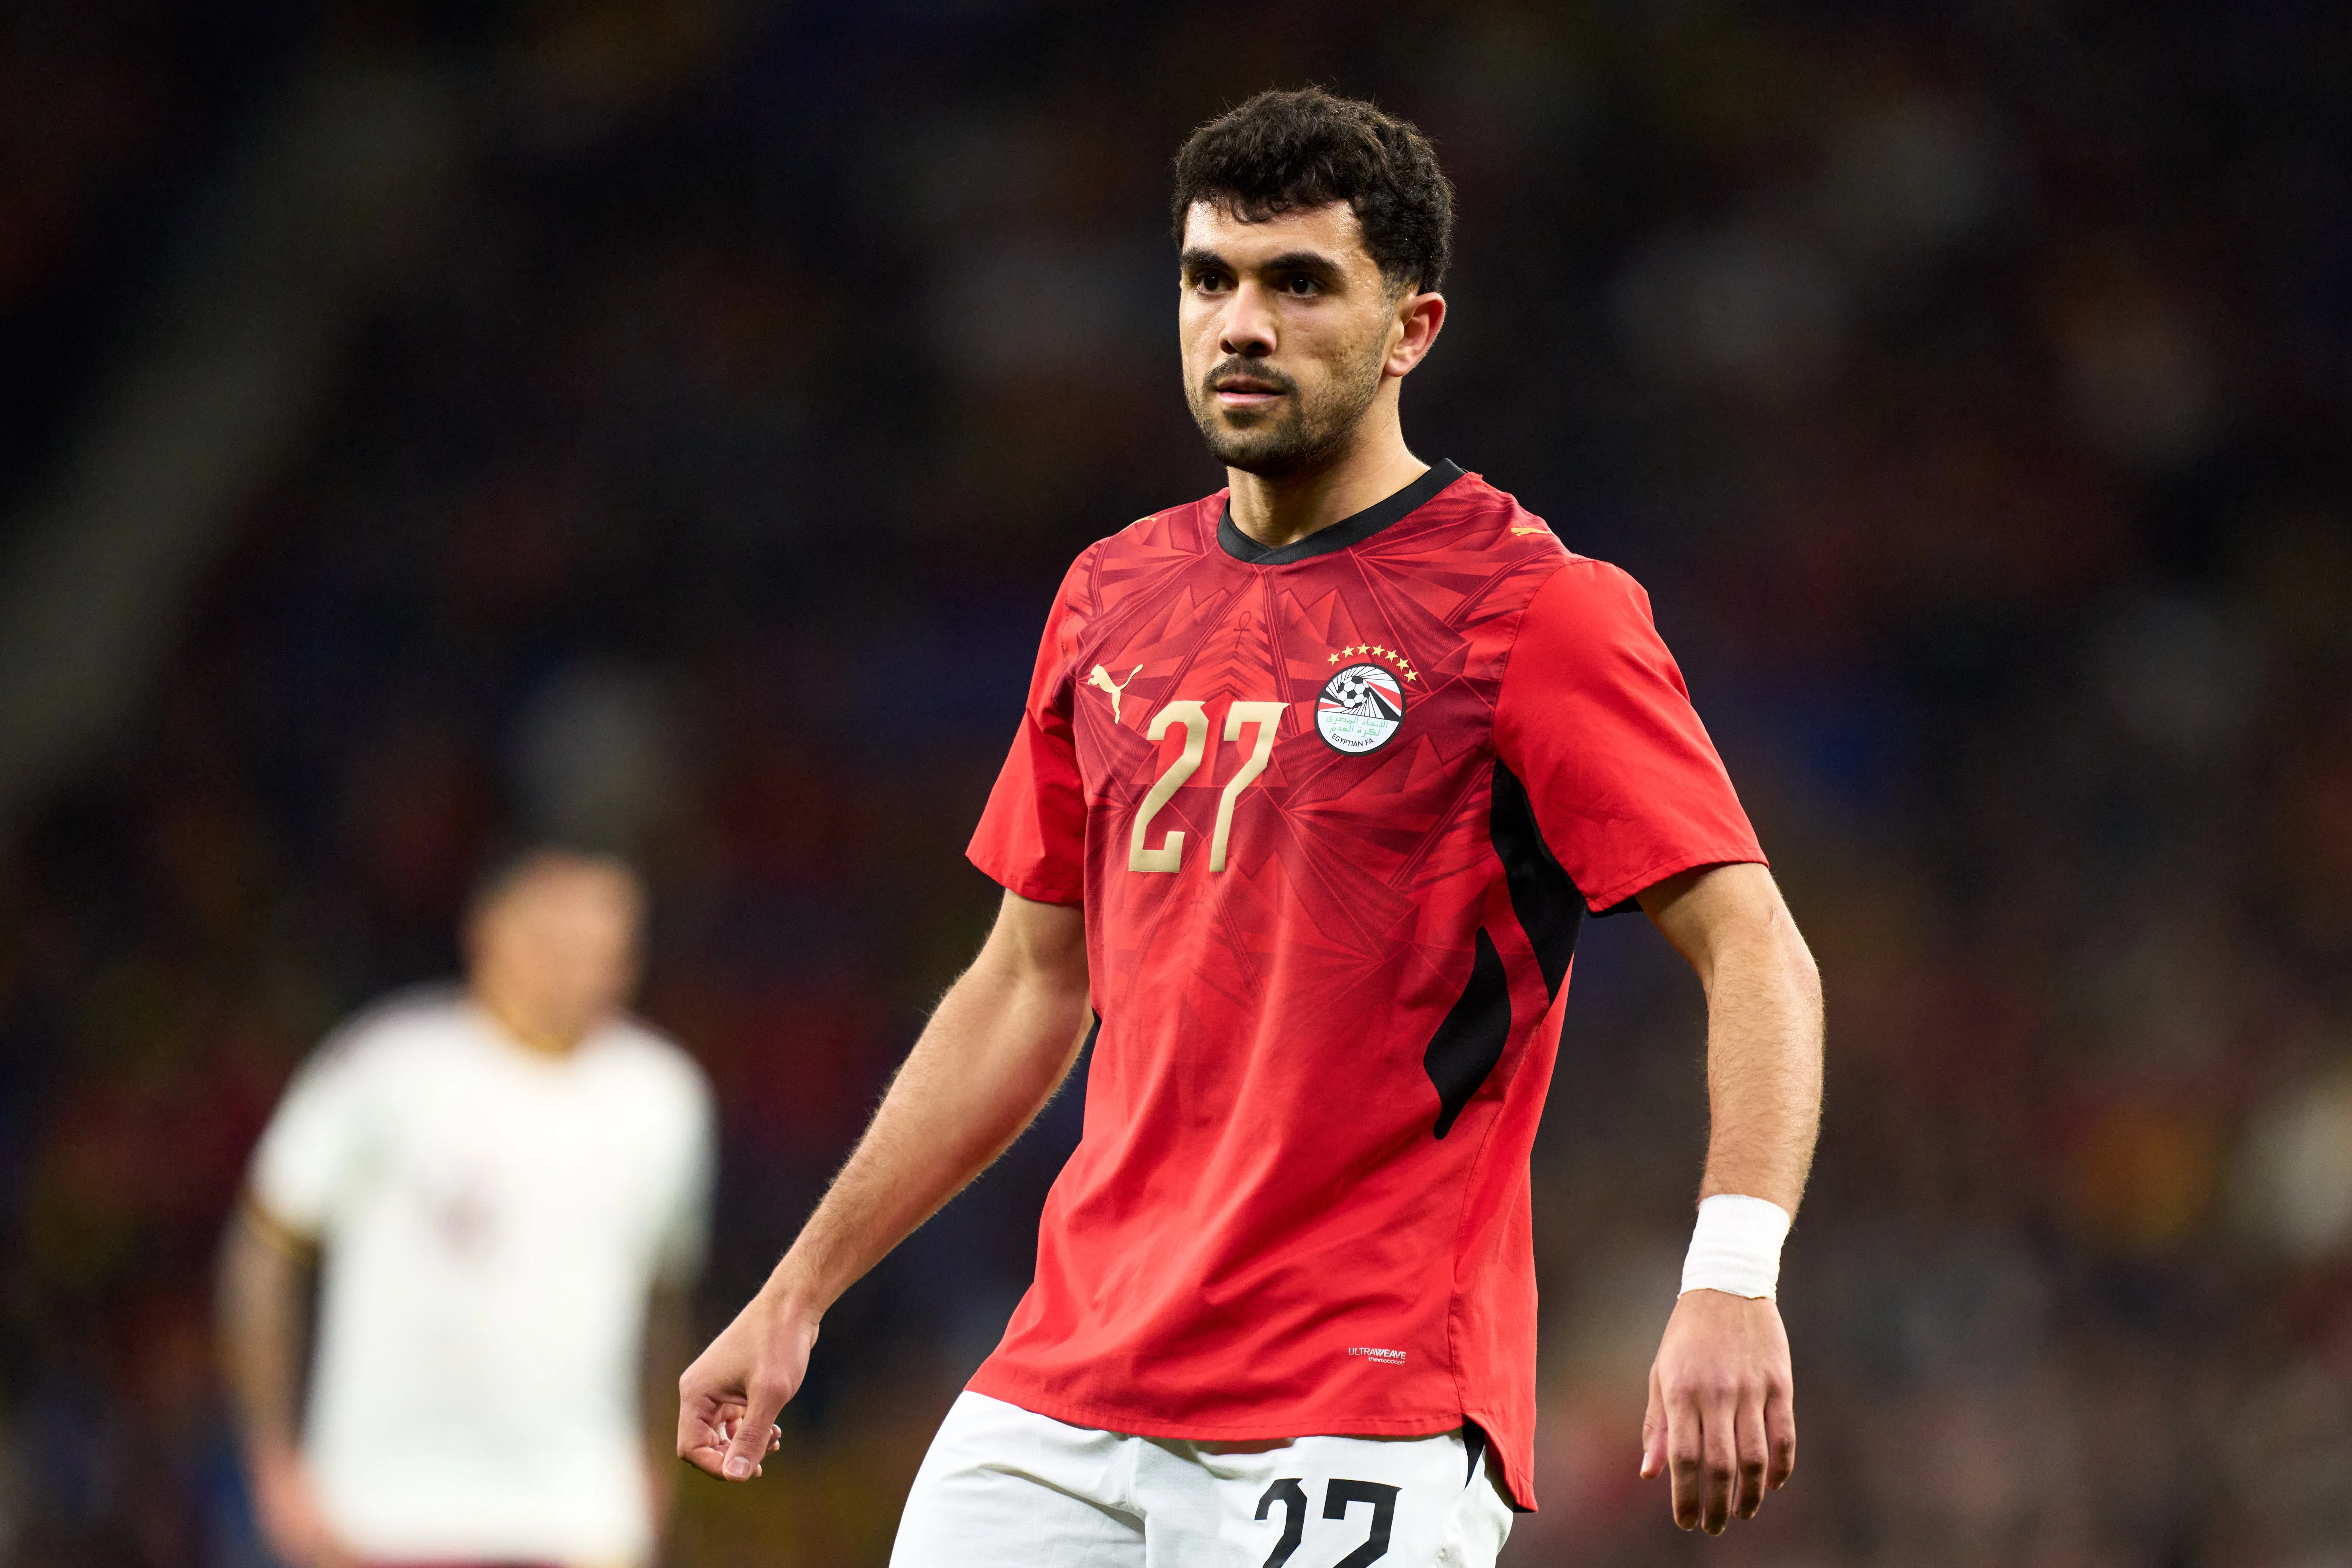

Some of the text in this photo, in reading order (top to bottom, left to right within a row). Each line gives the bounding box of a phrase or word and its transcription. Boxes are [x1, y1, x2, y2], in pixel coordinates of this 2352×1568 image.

[1326, 716, 1388, 728] الاتحاد المصري
[1329, 725, 1380, 737] لكرة القدم
[1331, 733, 1363, 747] EGYPTIAN
[1129, 701, 1290, 873] 27
[1348, 1347, 1406, 1360] ULTRAWEAVE
